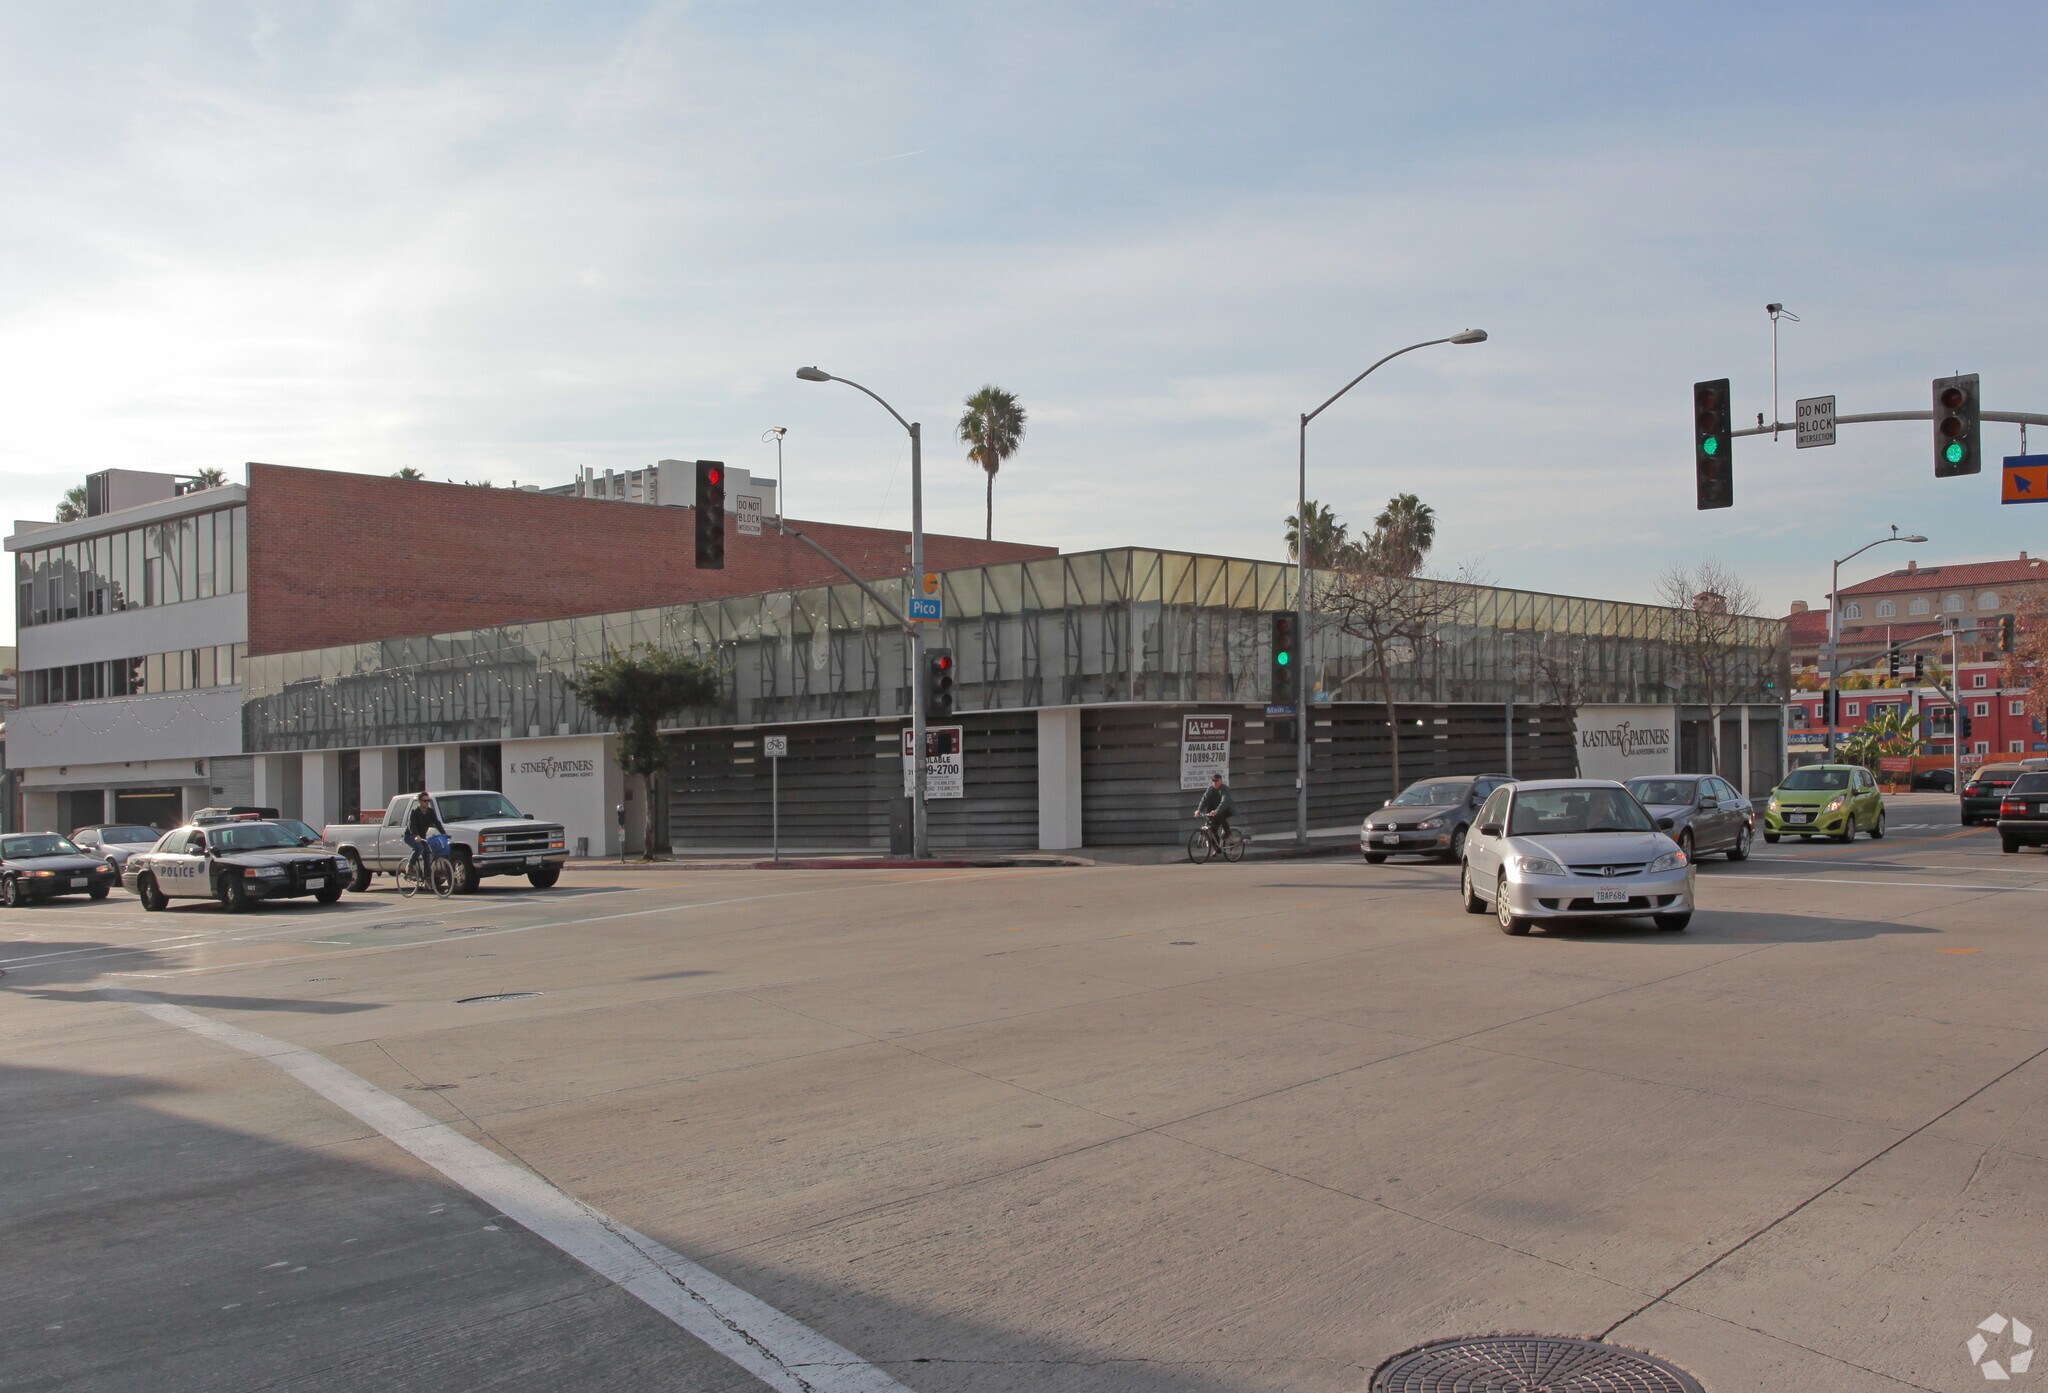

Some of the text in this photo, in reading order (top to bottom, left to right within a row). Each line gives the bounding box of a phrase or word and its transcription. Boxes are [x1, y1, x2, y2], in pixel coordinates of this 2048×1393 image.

[1799, 402, 1832, 417] DO NOT
[1799, 418, 1832, 432] BLOCK
[1799, 433, 1833, 443] INTERSECTION
[738, 501, 760, 511] DO NOT
[738, 513, 760, 523] BLOCK
[914, 601, 936, 614] Pico
[1266, 705, 1284, 714] Main
[1582, 730, 1622, 747] KASTNER
[1630, 729, 1669, 745] PARTNERS
[1188, 743, 1225, 751] AVAILABLE
[1185, 752, 1226, 763] 310/899-2700
[554, 760, 593, 771] PARTNERS
[161, 866, 194, 878] POLICE
[1596, 891, 1627, 900] 7BAP686
